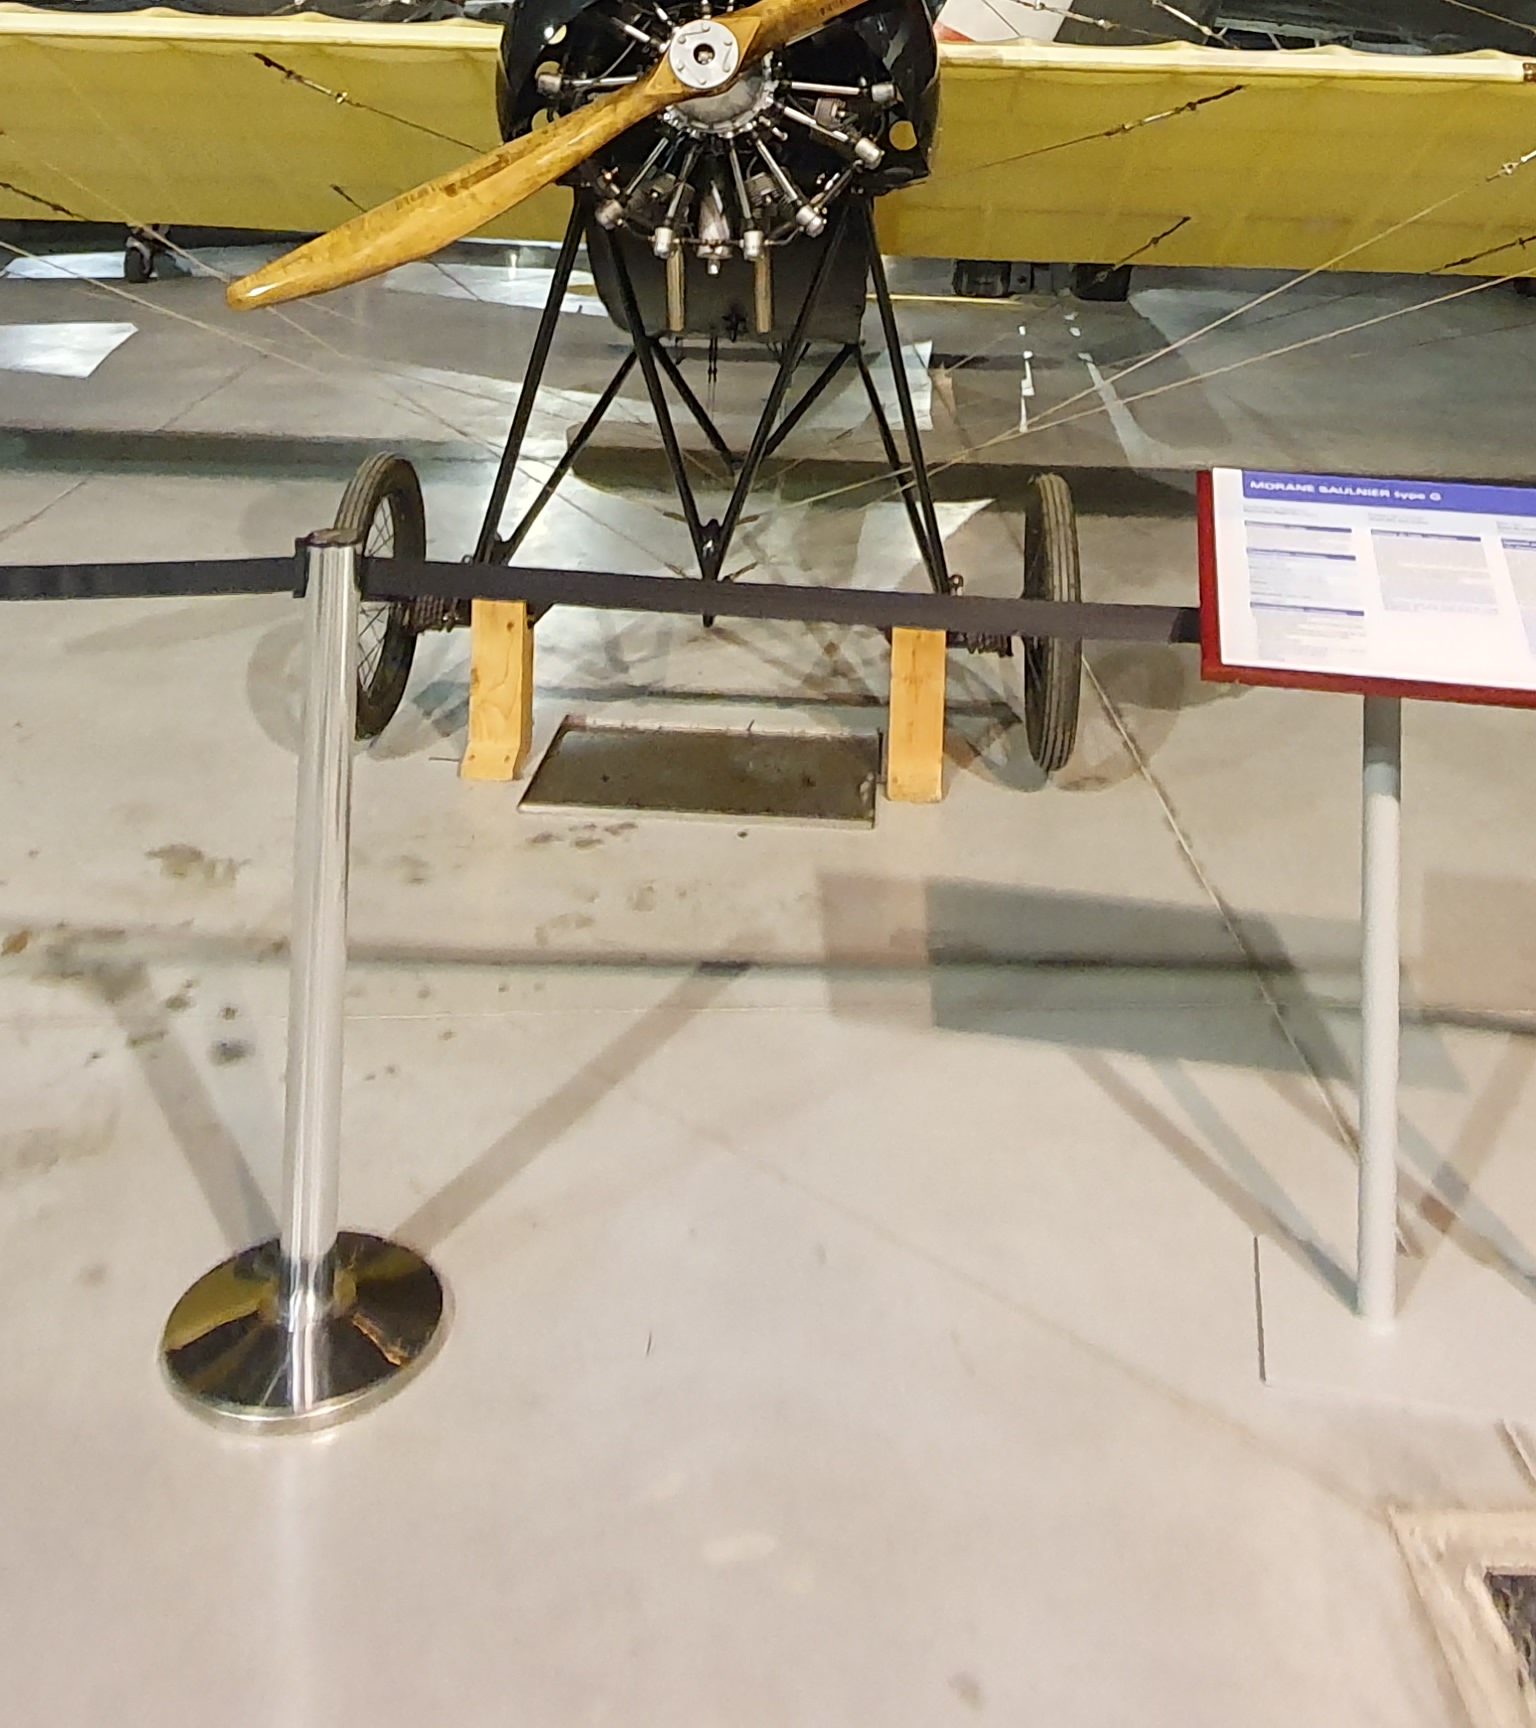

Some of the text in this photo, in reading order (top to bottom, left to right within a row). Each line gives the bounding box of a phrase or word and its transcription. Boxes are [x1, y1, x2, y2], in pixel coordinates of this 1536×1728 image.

[1249, 480, 1315, 493] MORANE
[1318, 485, 1391, 498] SAULNIER
[1394, 491, 1427, 501] type
